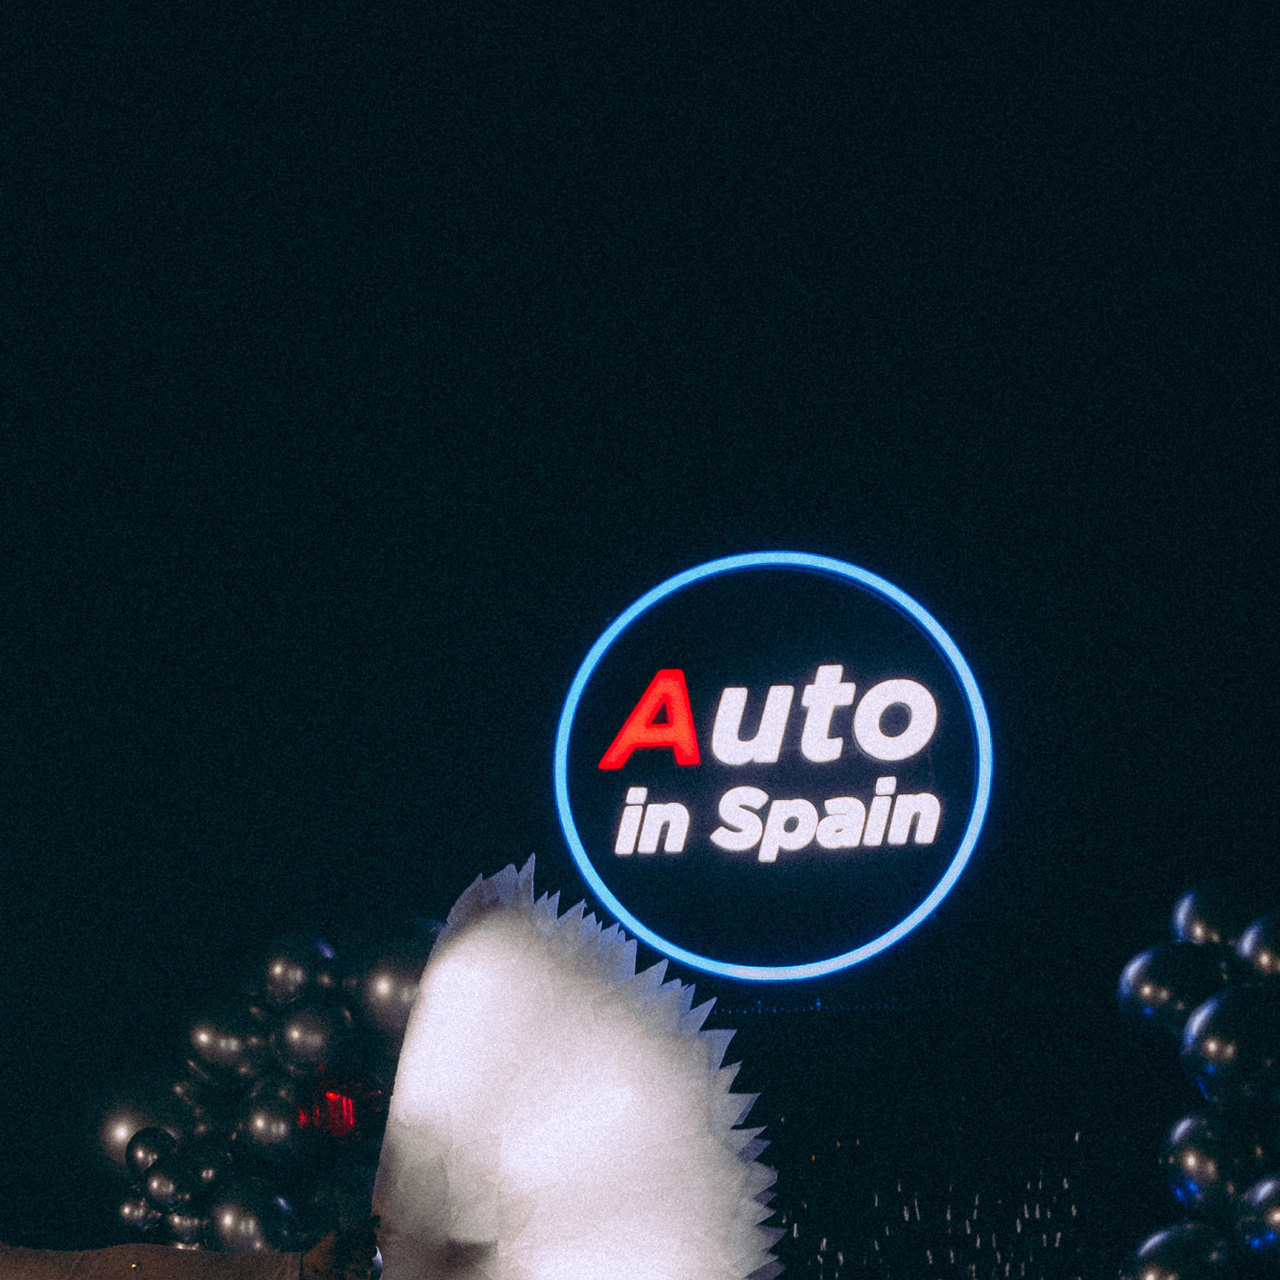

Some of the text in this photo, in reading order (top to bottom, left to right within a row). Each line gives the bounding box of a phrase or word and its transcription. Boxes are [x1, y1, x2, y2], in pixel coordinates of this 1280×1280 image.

[598, 665, 938, 770] Auto
[615, 776, 941, 863] in Spain
